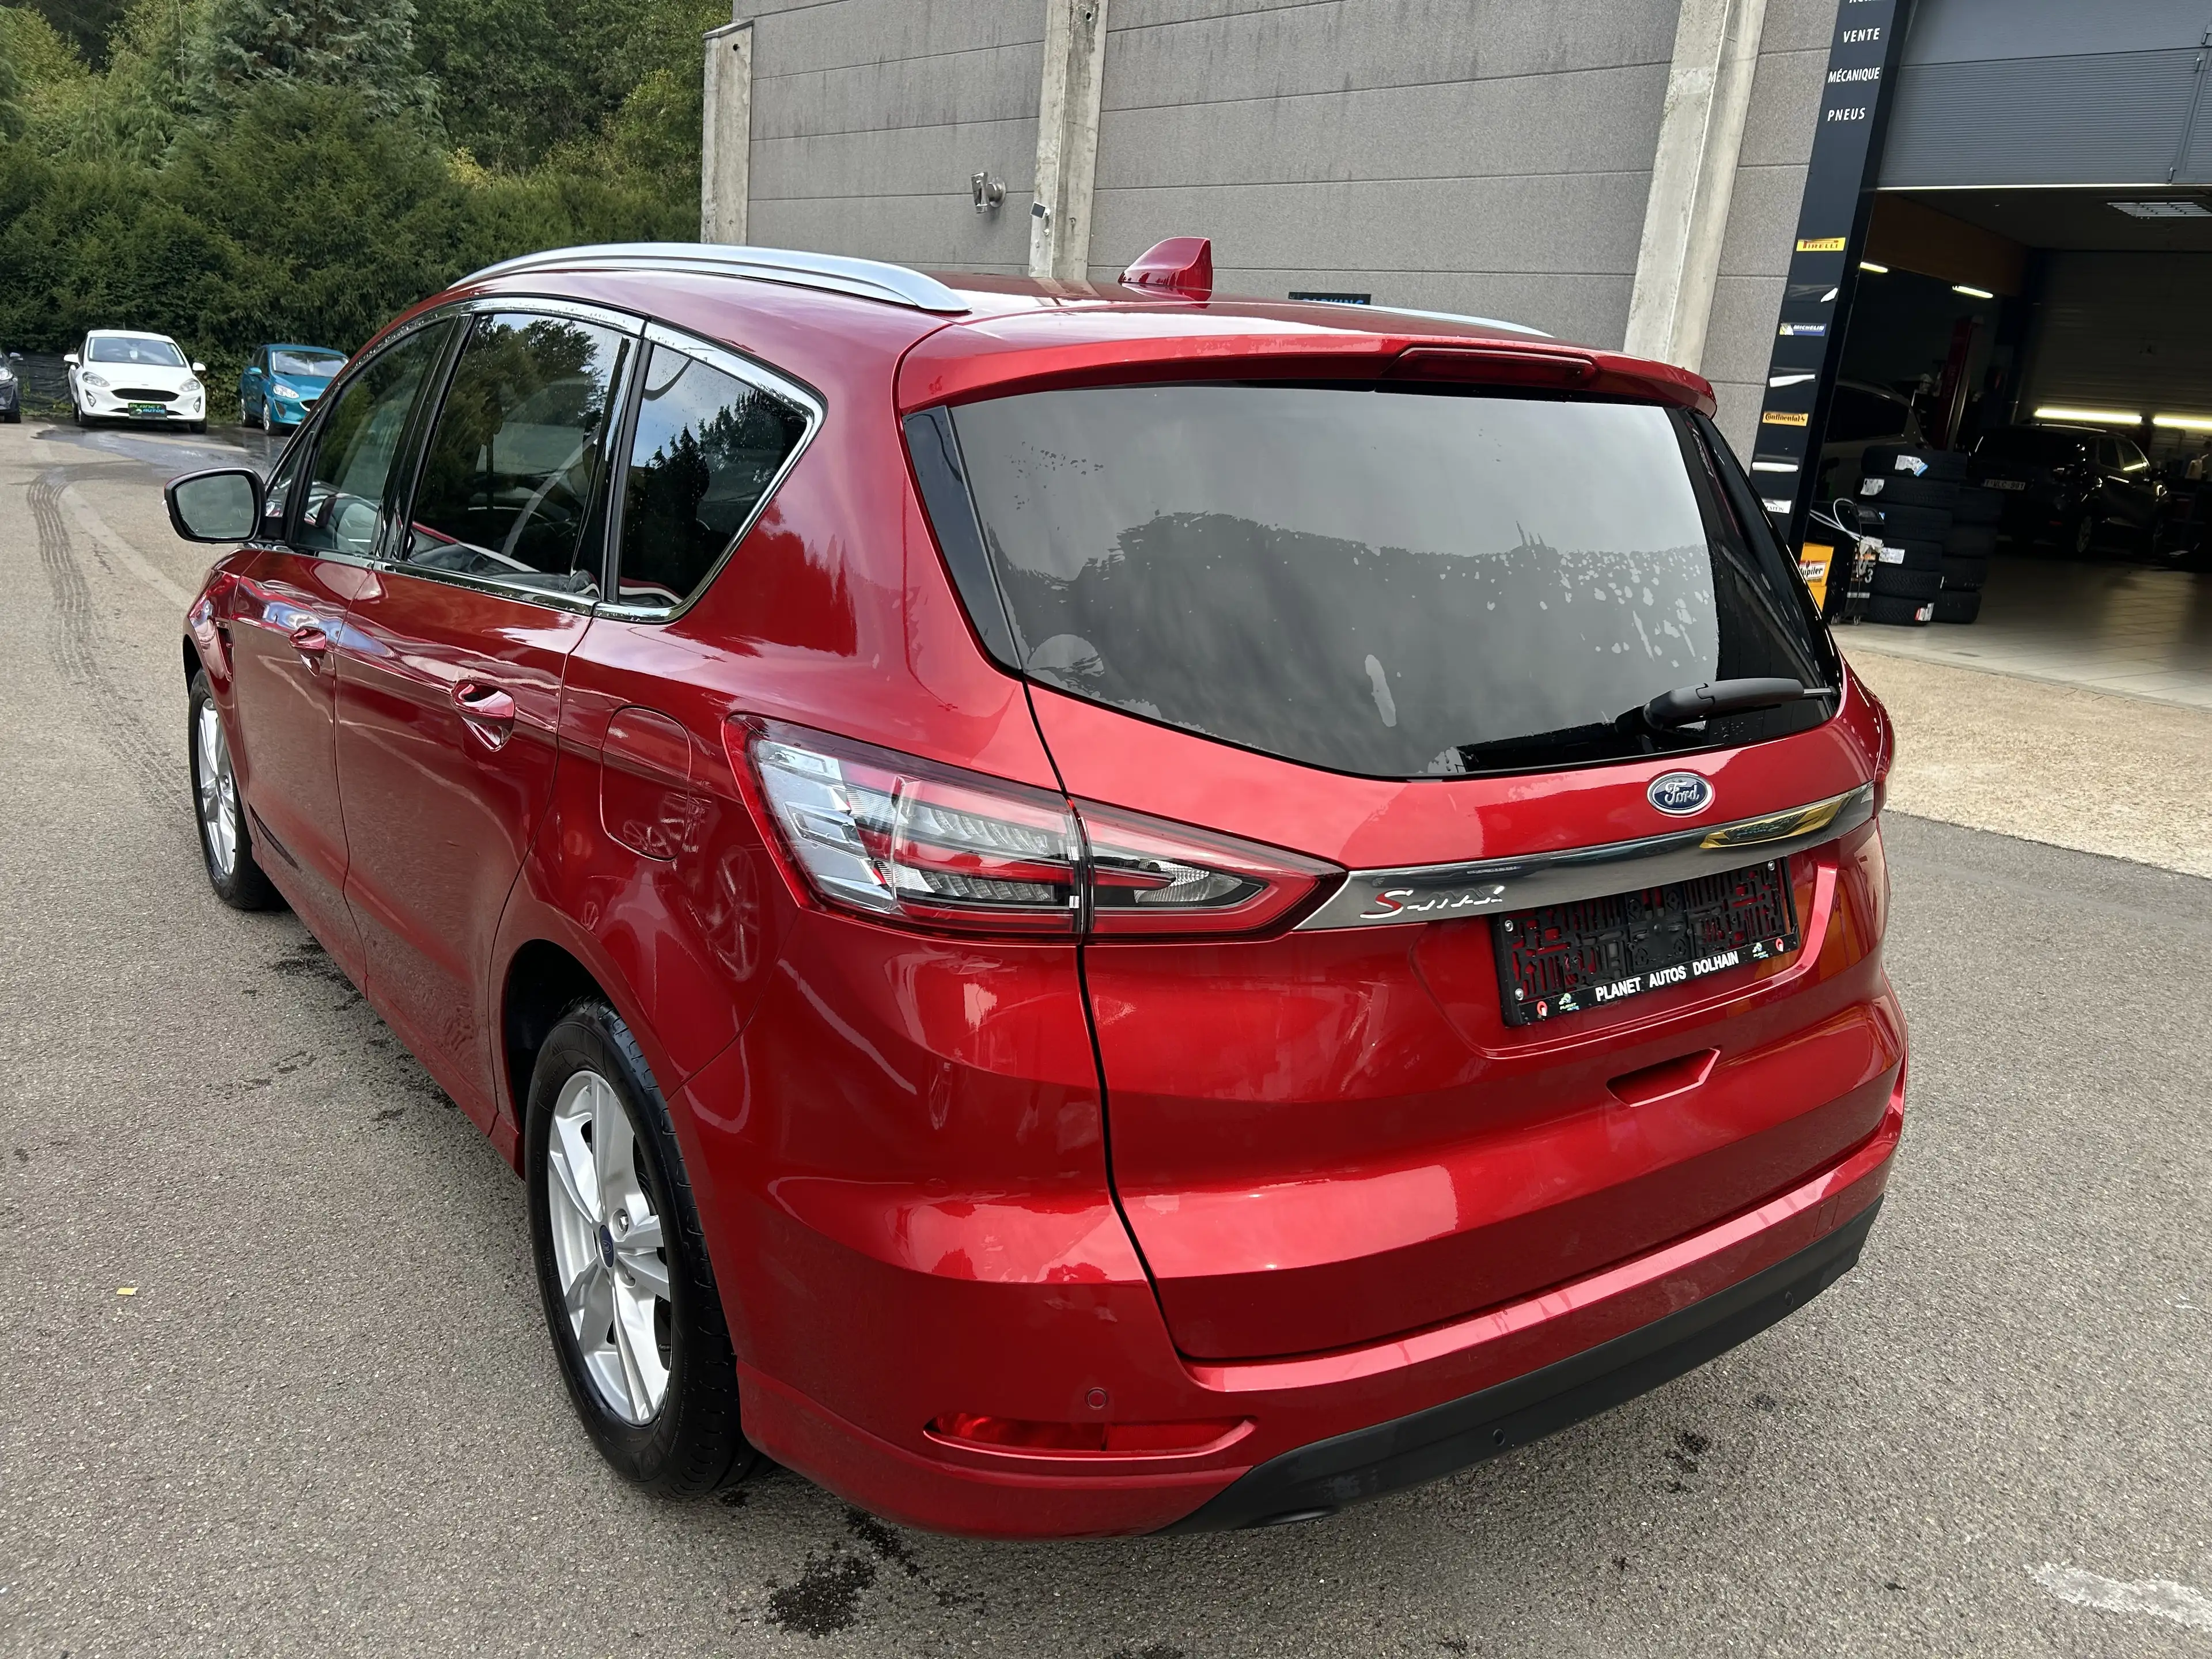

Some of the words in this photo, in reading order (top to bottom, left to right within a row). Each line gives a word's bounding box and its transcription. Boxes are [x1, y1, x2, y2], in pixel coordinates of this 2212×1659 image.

[1843, 28, 1880, 43] VENTE
[1828, 67, 1881, 83] MÉCANIQUE
[1827, 107, 1866, 122] PNEUS
[1765, 412, 1800, 422] Continental
[1664, 781, 1700, 805] Ford
[1595, 977, 1641, 1002] PLANET
[1649, 965, 1687, 988] AUTOS
[1692, 950, 1740, 976] DOLHAIN
